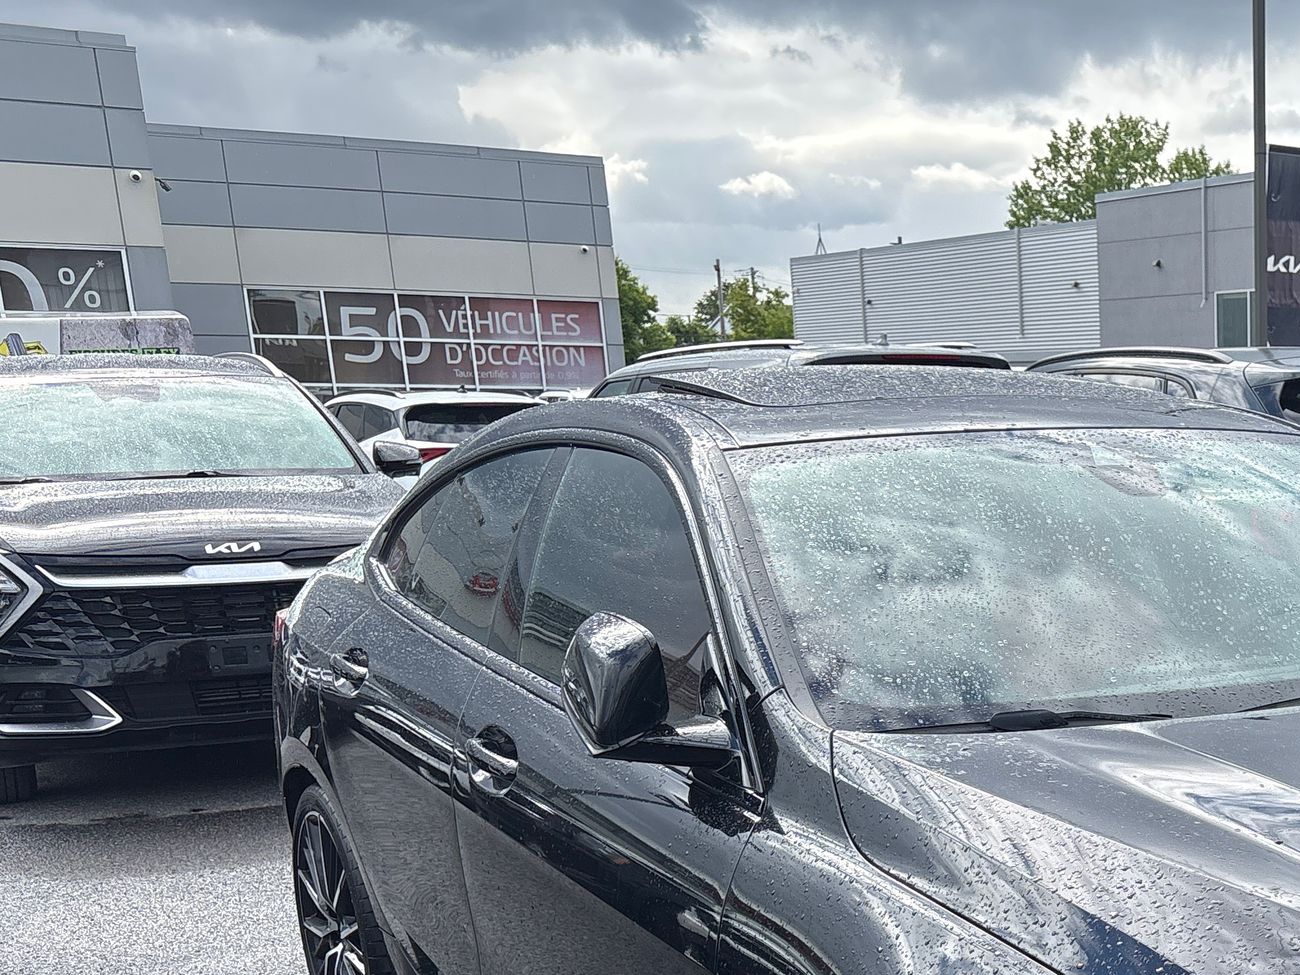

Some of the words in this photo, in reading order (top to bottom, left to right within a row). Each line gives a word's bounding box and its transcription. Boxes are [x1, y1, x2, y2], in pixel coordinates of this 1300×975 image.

[339, 305, 432, 365] 50
[438, 303, 581, 337] VÉHICULES
[444, 343, 586, 367] D'OCCASION
